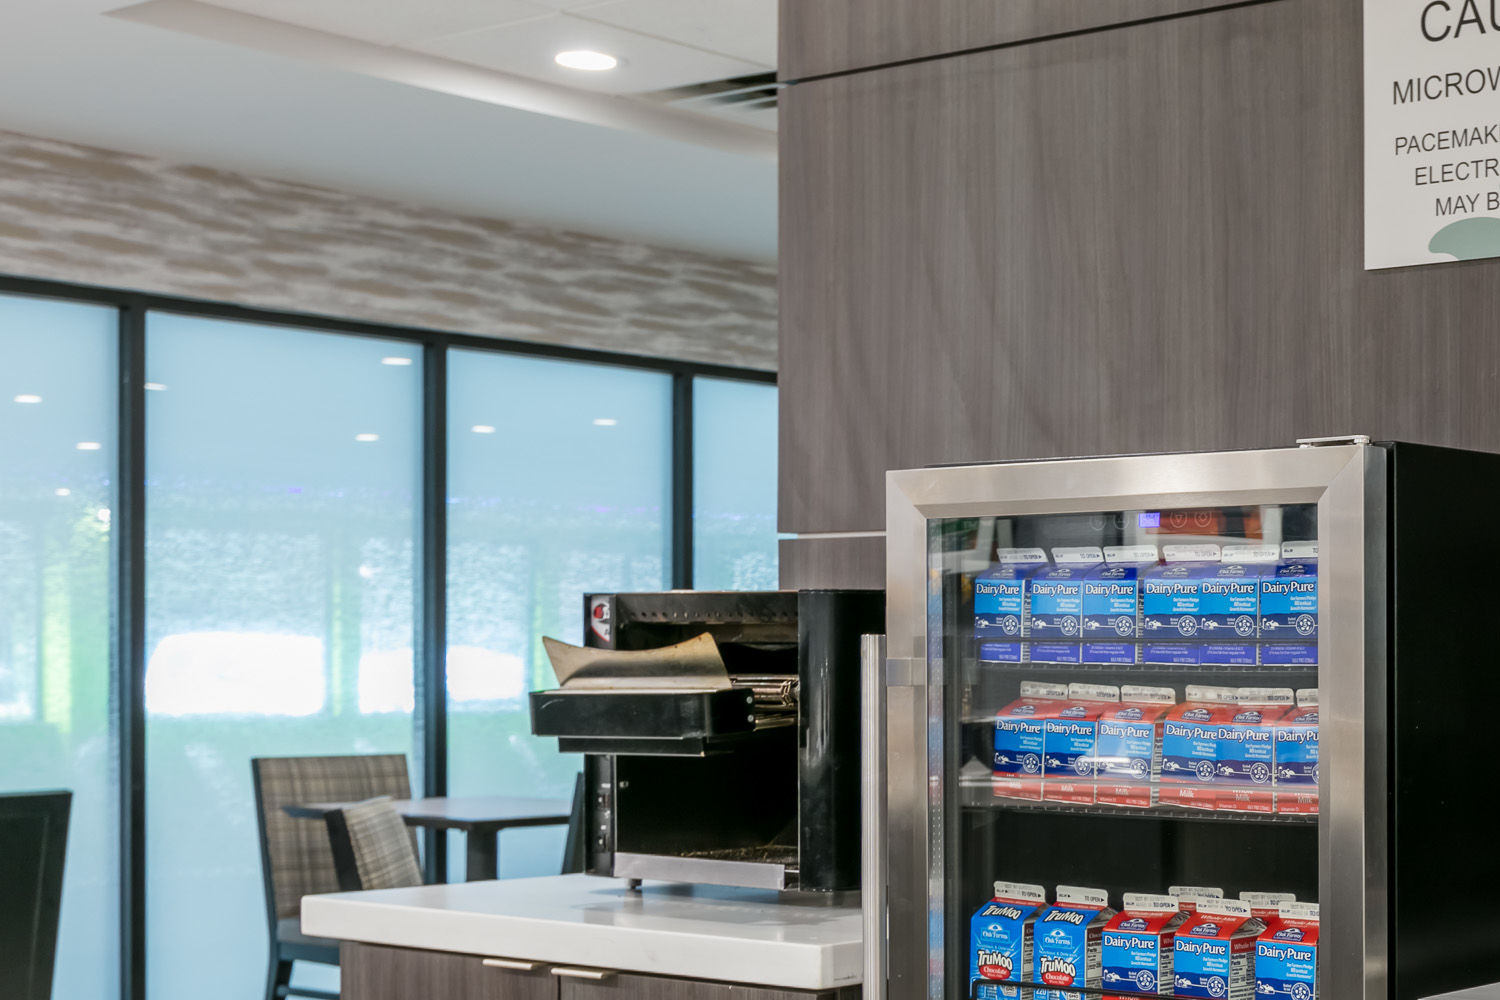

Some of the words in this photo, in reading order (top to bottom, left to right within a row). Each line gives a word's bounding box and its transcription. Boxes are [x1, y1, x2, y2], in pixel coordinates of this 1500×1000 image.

[1435, 194, 1479, 217] MAY
[976, 583, 1020, 597] DairyPure
[1032, 584, 1078, 597] DairyPure
[1085, 584, 1133, 597] DairyPure
[1146, 583, 1197, 596] DairyPure
[1202, 583, 1254, 596] DairyPure
[1263, 582, 1314, 595] DairyPure
[996, 720, 1040, 734] DairyPure
[1047, 723, 1092, 736] DairyPure
[1101, 724, 1149, 738] DairyPure
[1166, 725, 1216, 739] DairyPure
[1218, 729, 1269, 742] DairyPure
[1278, 731, 1319, 743] DairyPu
[982, 905, 1022, 919] TruMoo
[1044, 910, 1084, 925] TruMoo
[1104, 935, 1155, 949] DairyPure
[1176, 940, 1225, 955] DairyPure
[1258, 945, 1311, 960] DairyPure
[977, 950, 1013, 970] TruMoo
[1040, 957, 1076, 977] TruMoo
